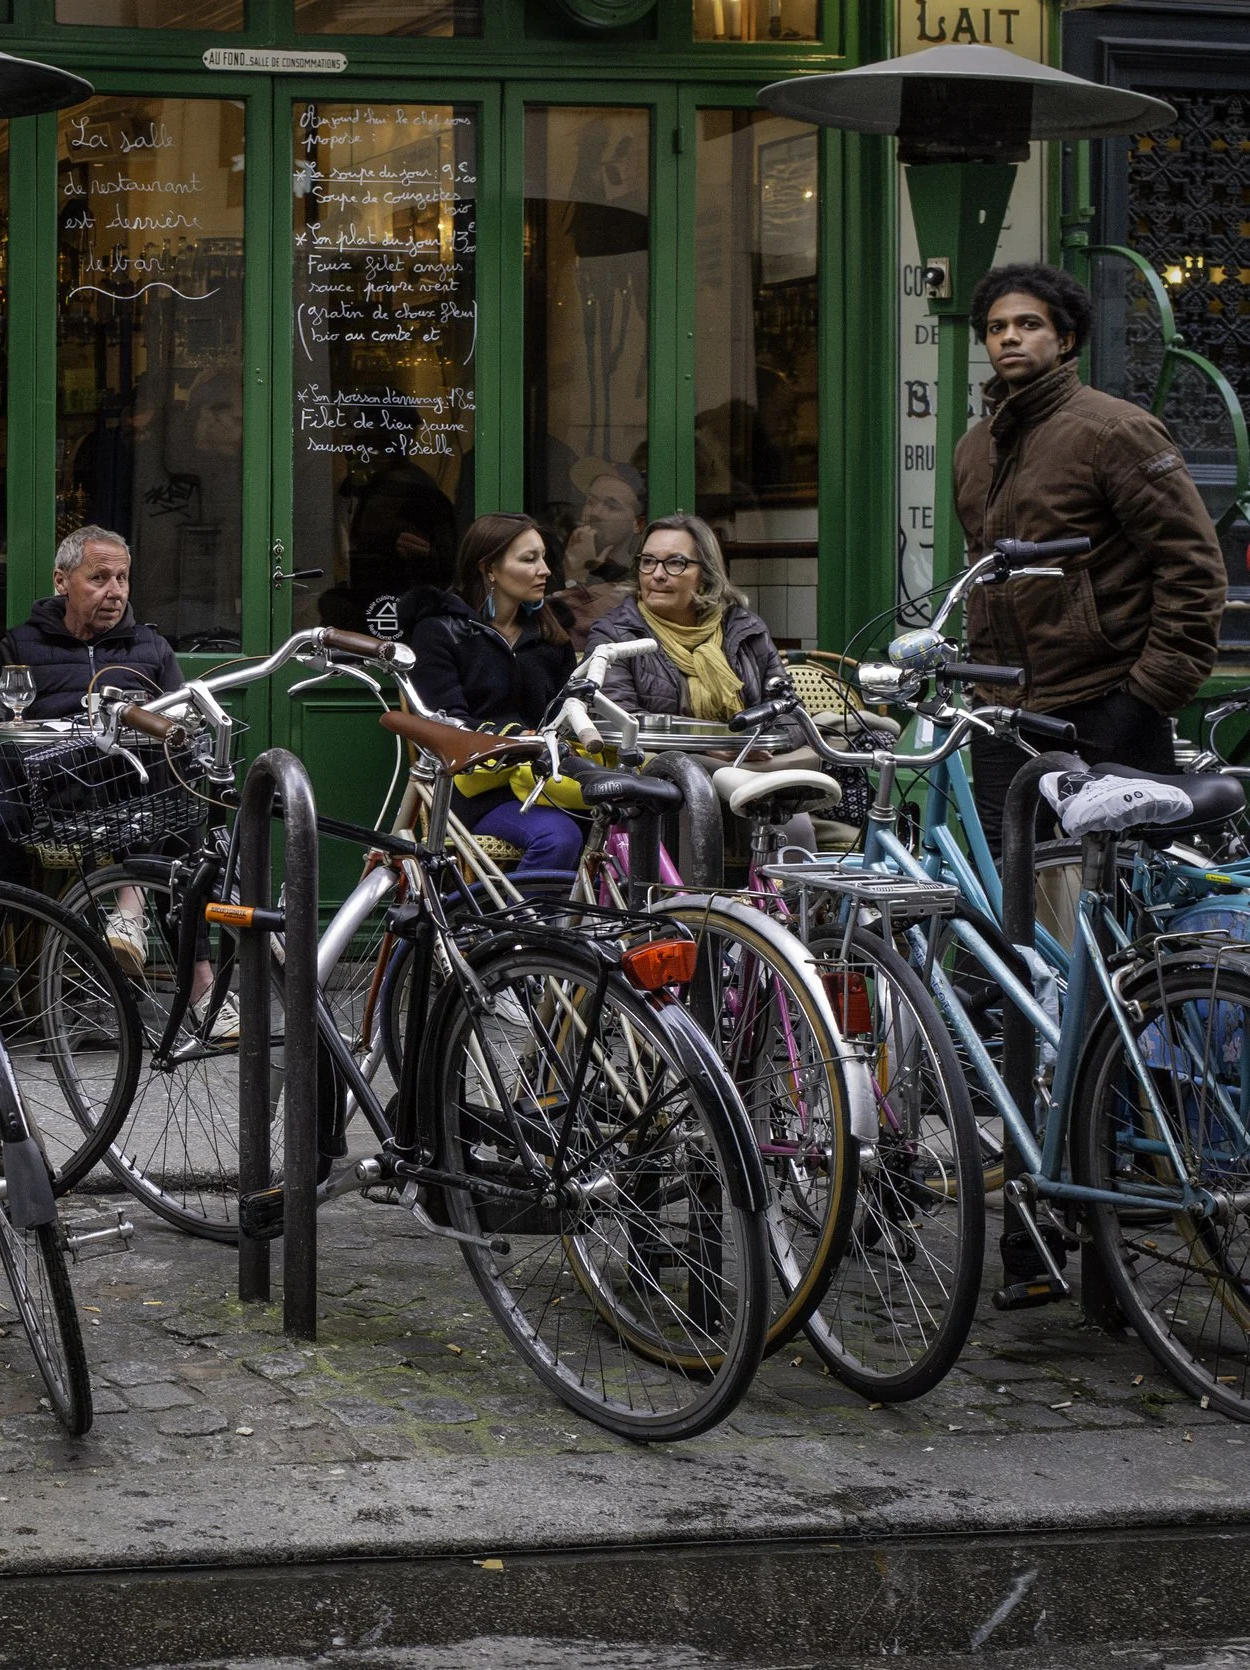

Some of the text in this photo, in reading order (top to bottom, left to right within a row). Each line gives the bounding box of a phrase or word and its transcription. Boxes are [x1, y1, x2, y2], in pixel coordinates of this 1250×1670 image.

[916, 0, 1020, 44] LAIT
[209, 52, 220, 65] AU
[271, 57, 279, 67] DE
[281, 57, 341, 69] CONSOMMATIONS
[71, 116, 175, 152] La salle
[63, 171, 203, 195] de restaurant
[330, 166, 375, 186] soupe
[379, 165, 399, 179] du
[312, 186, 356, 211] Soupe
[362, 190, 378, 204] de
[65, 203, 203, 230] est derrière
[335, 223, 377, 253] plat
[382, 232, 404, 246] du
[308, 254, 464, 281] Faux filet angus
[308, 277, 461, 302] sauce poivre vert
[372, 304, 389, 320] de
[394, 302, 436, 319] choux
[311, 327, 340, 342] bio
[345, 333, 366, 342] au
[423, 328, 441, 342] et
[333, 387, 380, 406] poisson
[300, 405, 468, 444] Filet de lieu jaune
[307, 436, 379, 463] sauvage
